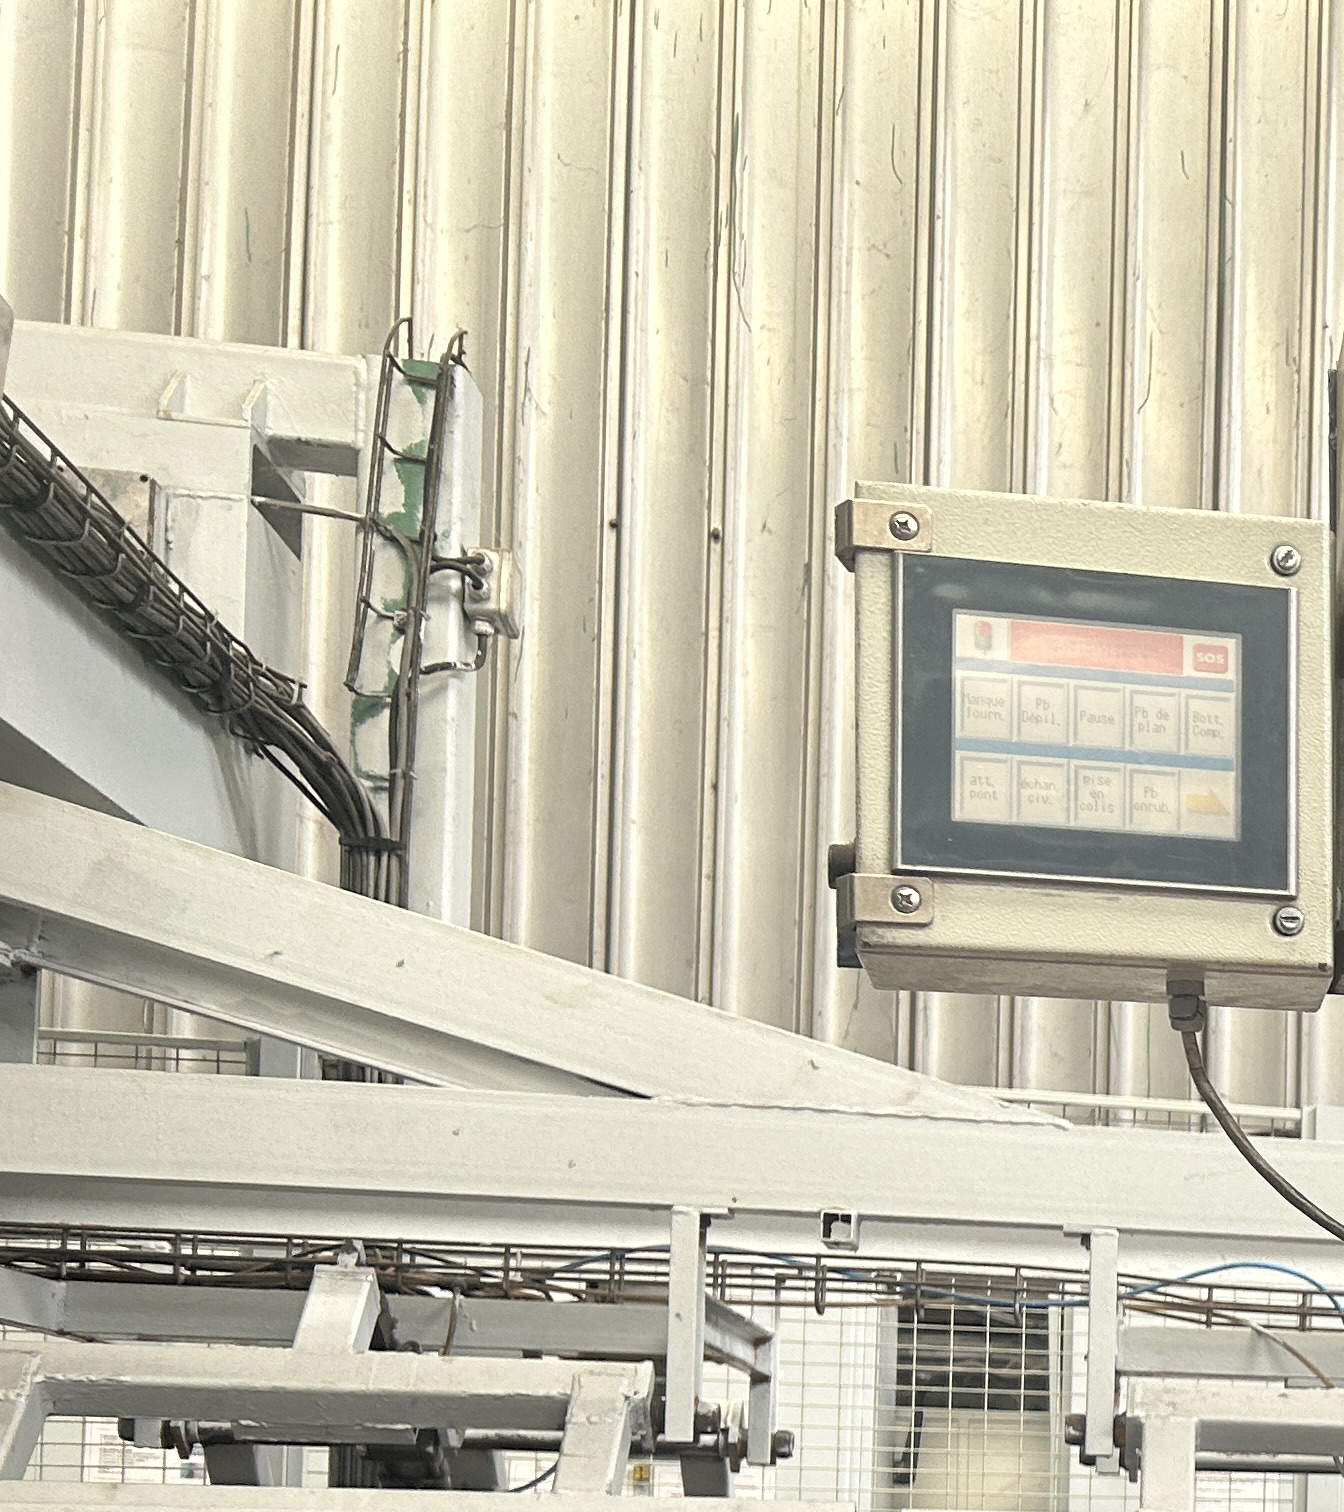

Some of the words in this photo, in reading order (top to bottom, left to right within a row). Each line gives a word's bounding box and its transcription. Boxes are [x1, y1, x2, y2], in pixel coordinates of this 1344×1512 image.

[1195, 652, 1225, 664] SOS
[1035, 697, 1050, 710] Pb
[966, 707, 1005, 722] fourn.
[1079, 709, 1115, 725] Pause
[1134, 706, 1149, 719] Pb
[1156, 708, 1169, 721] de
[1138, 720, 1167, 734] plan
[970, 775, 994, 788] att.
[1082, 775, 1111, 786] mise
[1090, 790, 1105, 800] en
[1143, 786, 1158, 799] Pb
[1079, 799, 1115, 814] colis
[1133, 801, 1171, 815] enrub.
